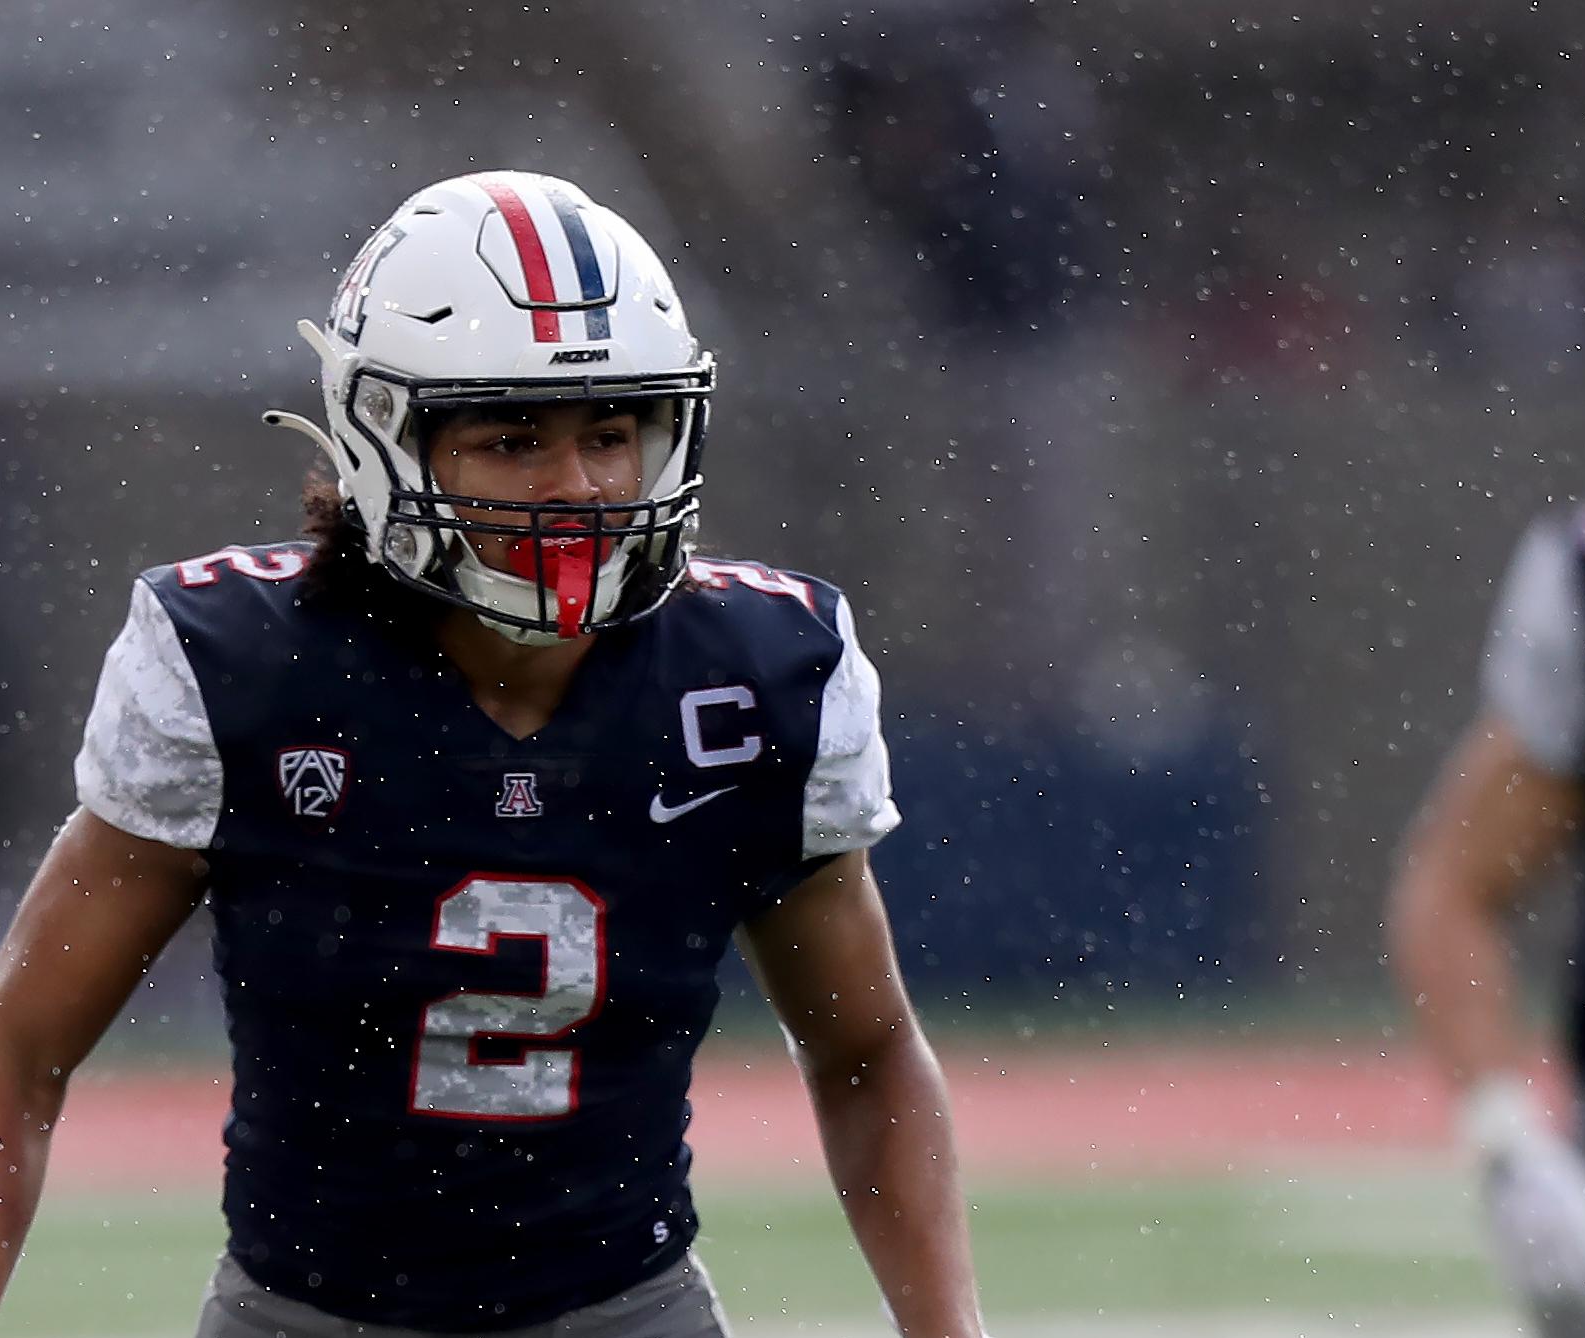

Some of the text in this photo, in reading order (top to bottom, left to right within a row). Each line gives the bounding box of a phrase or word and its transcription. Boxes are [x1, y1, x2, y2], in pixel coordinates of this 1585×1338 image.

[679, 685, 761, 768] C
[279, 749, 347, 801] PAC
[495, 772, 542, 817] A
[295, 786, 328, 817] 12
[407, 871, 607, 1122] 2
[653, 1220, 670, 1244] S
